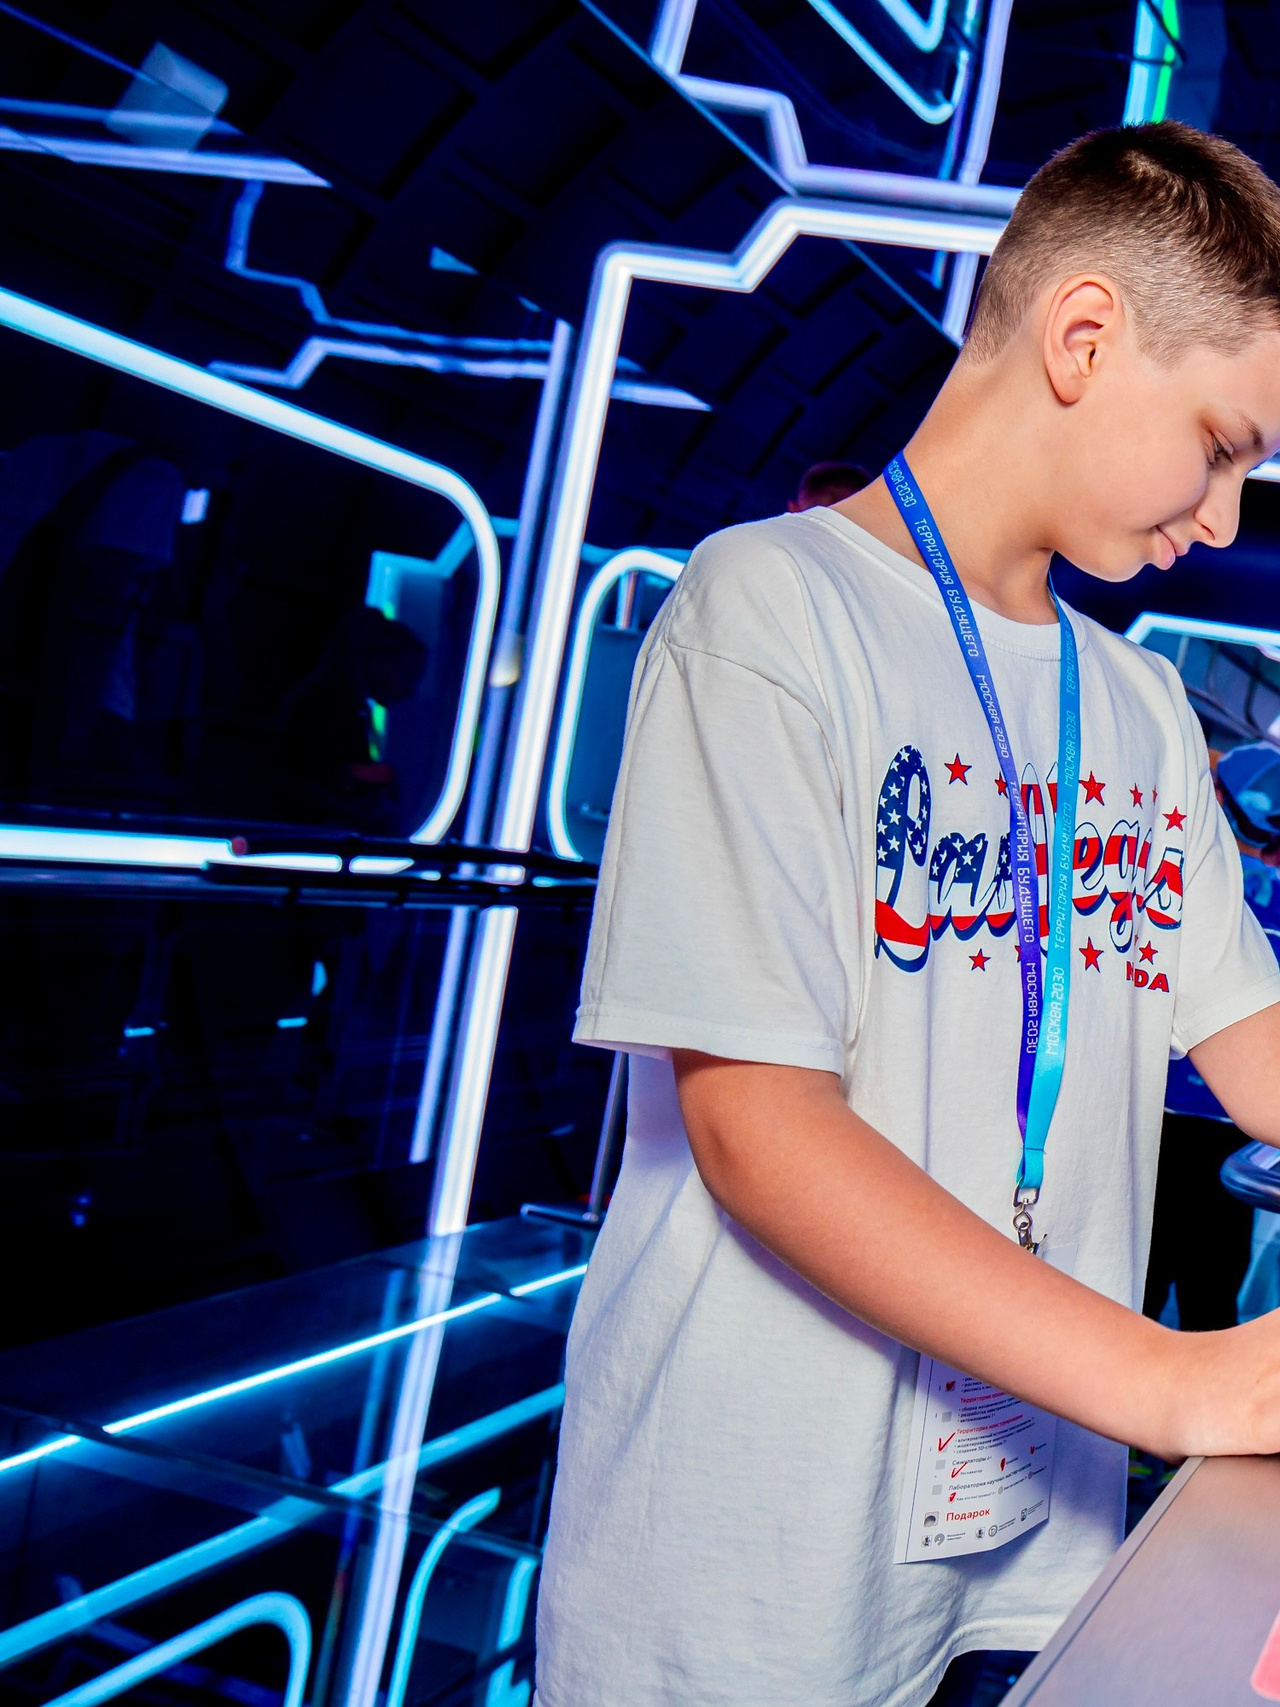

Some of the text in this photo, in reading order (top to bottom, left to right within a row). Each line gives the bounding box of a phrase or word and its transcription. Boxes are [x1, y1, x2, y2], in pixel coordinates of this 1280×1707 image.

[896, 481, 917, 508] 2030
[914, 518, 979, 657] ТЕРРИТОРИЯ БУДУЩЕГО
[975, 673, 1009, 759] МОСКВА 2030
[1064, 710, 1076, 787] МОСКВА 2030
[1010, 780, 1035, 943] ТЕРРИТОРИЯ БУДУЩЕГО
[1054, 802, 1073, 950] ТЕРРИТОРИЯ БУДУЩЕГО
[1026, 963, 1039, 1054] МОСКВА 2030
[1045, 966, 1065, 1055] МОСКВА 2030
[957, 1425, 989, 1434] Территория
[946, 1508, 991, 1522] Подарок
[948, 1480, 986, 1491] Лаборатория
